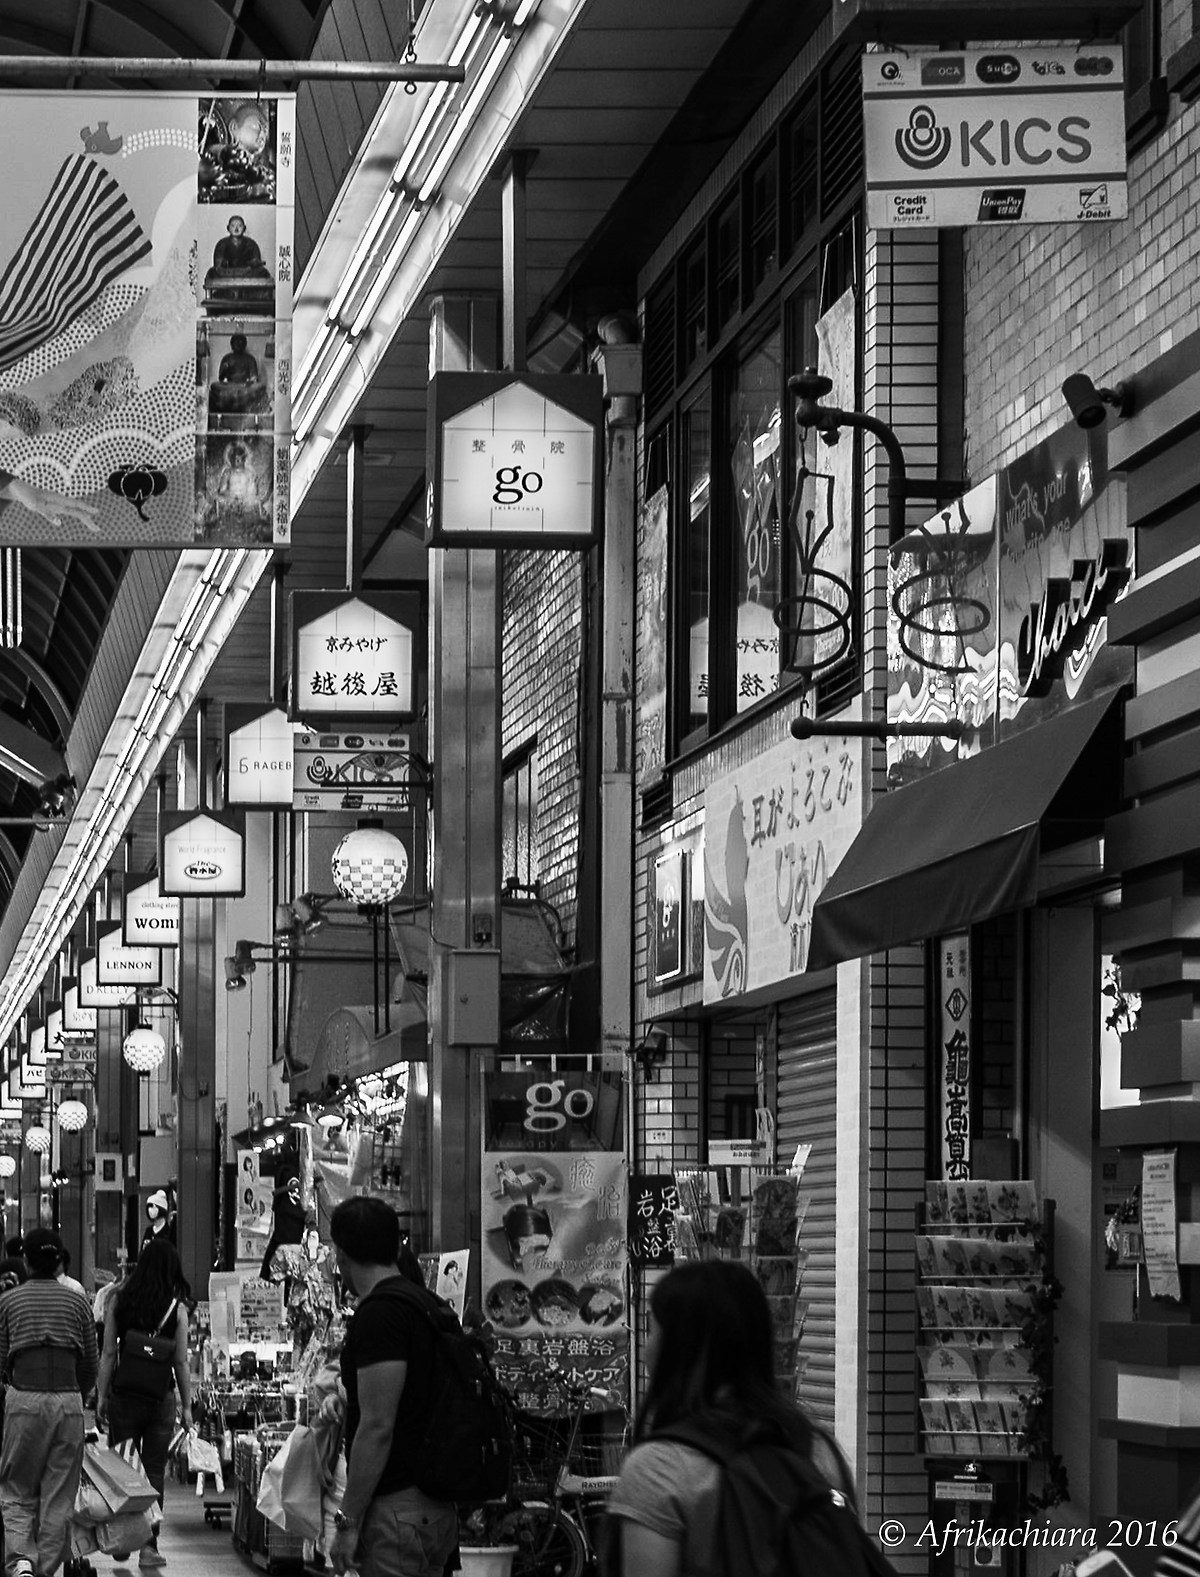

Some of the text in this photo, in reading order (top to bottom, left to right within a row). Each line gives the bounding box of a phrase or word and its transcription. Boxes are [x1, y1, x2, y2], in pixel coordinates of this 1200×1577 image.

[960, 116, 1092, 168] KICS
[893, 195, 928, 206] Credit
[896, 205, 924, 216] Card
[981, 195, 1024, 208] UnionPay
[278, 245, 292, 282] 誠心院
[277, 359, 290, 397] 西光寺
[471, 439, 566, 455] 整骨院
[492, 465, 543, 505] go
[1043, 471, 1069, 515] your
[325, 635, 388, 653] 京みやげ
[310, 671, 398, 697] 越後屋
[106, 961, 153, 971] LENNON
[523, 1079, 594, 1132] go
[636, 1188, 663, 1259] 岩盤浴
[493, 1338, 616, 1357] 足裏岩盤浴
